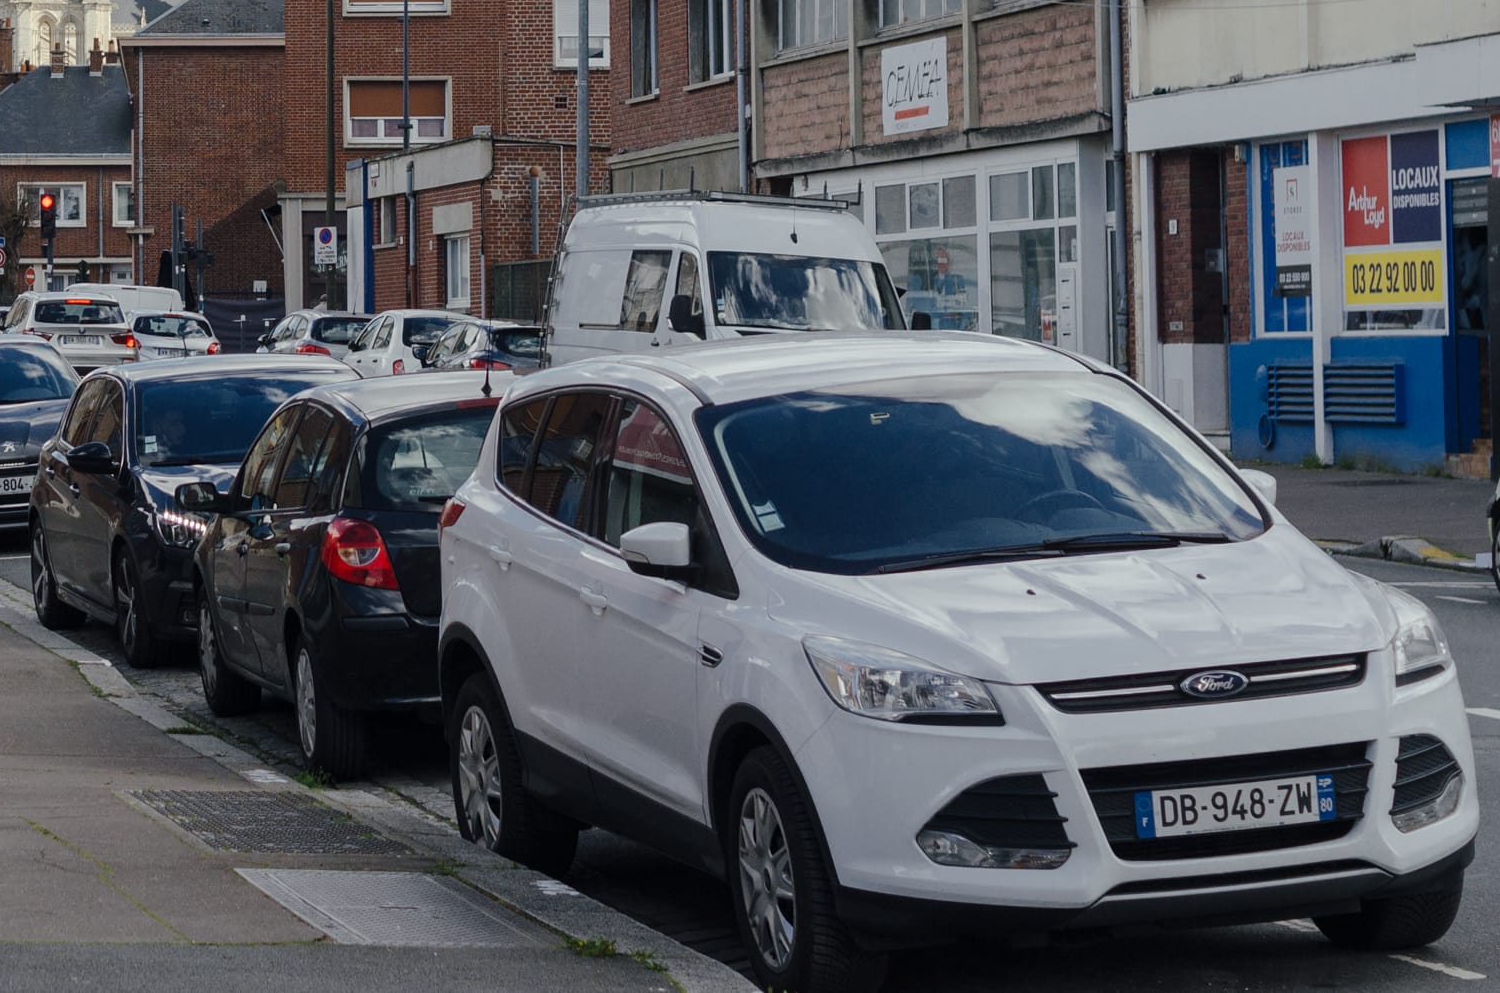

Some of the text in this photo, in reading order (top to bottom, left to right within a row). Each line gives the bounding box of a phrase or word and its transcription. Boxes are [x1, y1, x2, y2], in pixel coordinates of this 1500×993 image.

[1392, 165, 1439, 191] LOCAUX
[1348, 185, 1378, 212] Arthur
[1393, 192, 1440, 209] DISPONIBLES
[1364, 206, 1385, 228] Loyd
[1277, 241, 1311, 253] DISPONIBLES
[1282, 231, 1304, 242] LOCAUX
[1352, 260, 1435, 294] 03 22 92 00 00
[1197, 674, 1234, 692] Ford
[1159, 782, 1313, 828] DB-948-ZW
[1320, 797, 1333, 812] 80
